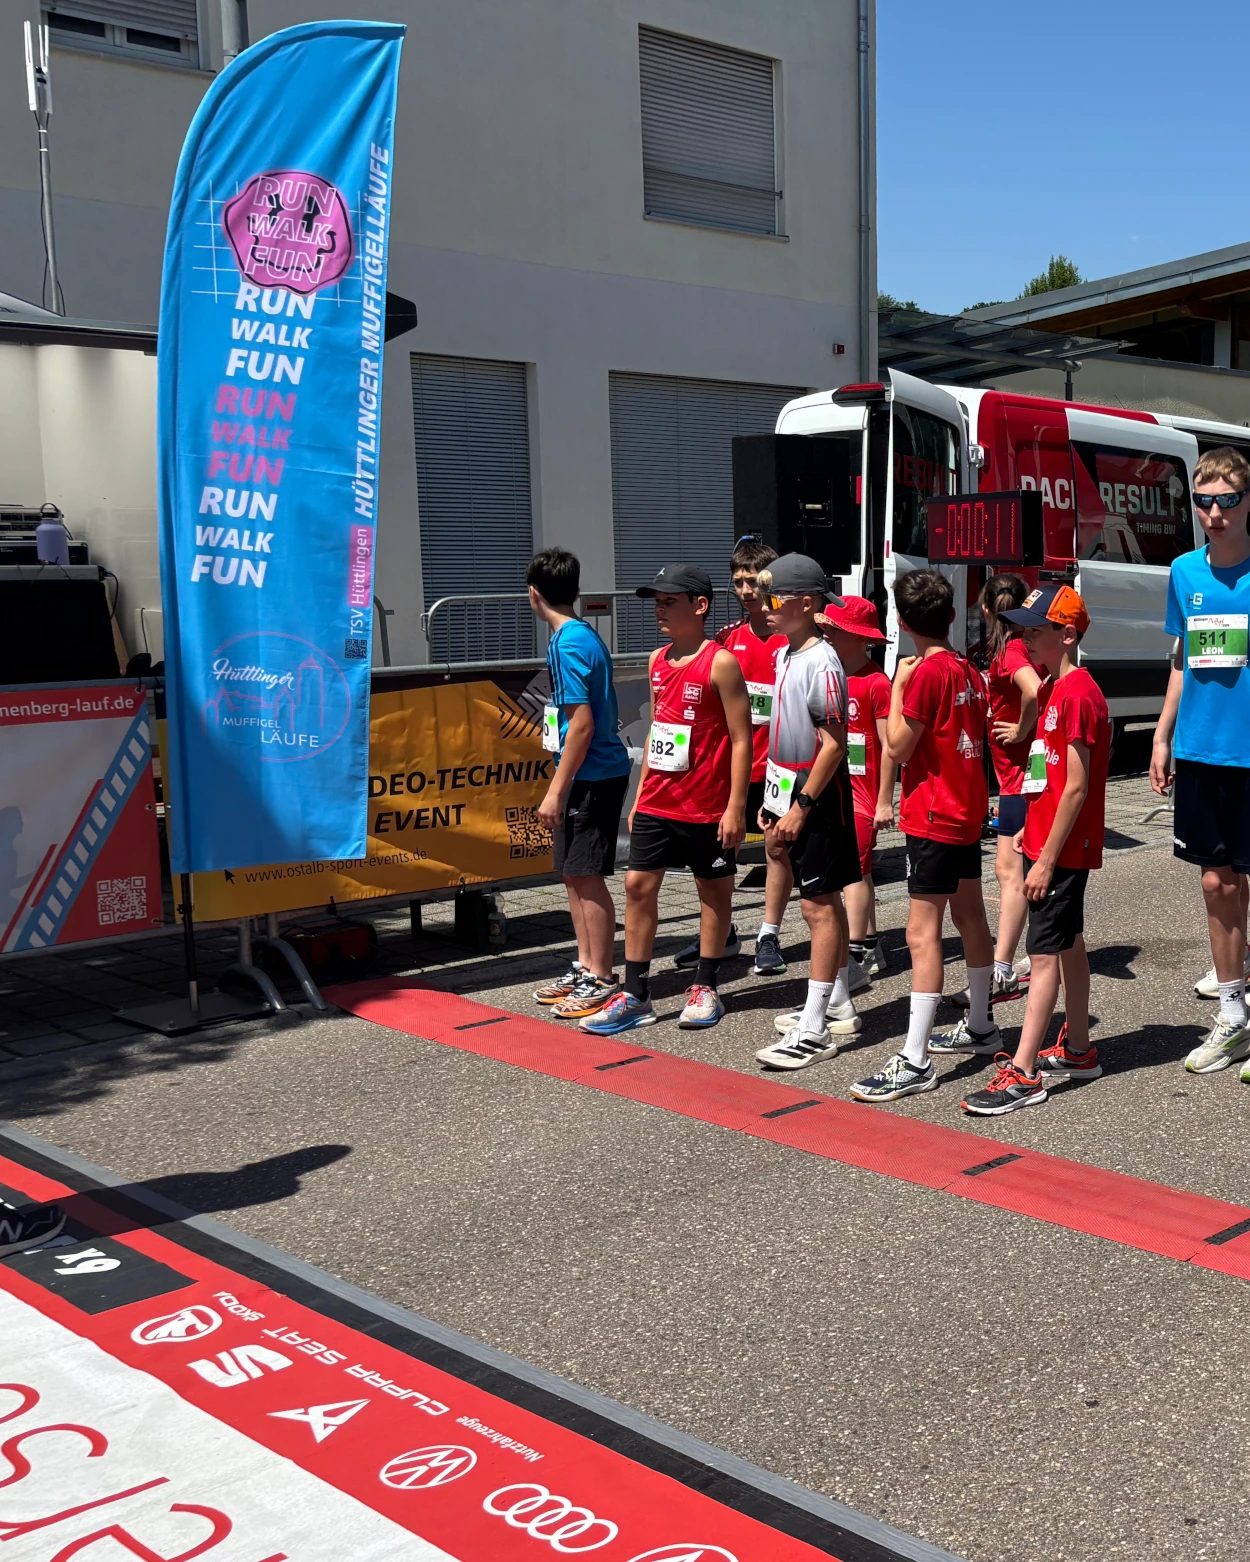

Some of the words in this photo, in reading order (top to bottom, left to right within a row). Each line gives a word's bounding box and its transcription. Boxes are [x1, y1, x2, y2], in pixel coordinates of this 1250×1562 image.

[253, 176, 336, 217] RUN
[250, 213, 332, 247] WALK
[244, 245, 325, 284] FUN
[361, 142, 389, 354] MUFFIGELLÄUFE
[235, 282, 317, 320] RUN
[231, 318, 313, 349] WALK
[225, 348, 305, 385] FUN
[215, 384, 297, 421] RUN
[211, 421, 293, 450] WALK
[352, 357, 379, 519] HÜTTLINGER
[207, 451, 285, 486] FUN
[198, 486, 278, 522] RUN
[1099, 481, 1176, 517] RESULT
[195, 525, 274, 553] WALK
[1136, 522, 1162, 534] TIMING
[1164, 524, 1176, 535] BW
[190, 554, 267, 589] FUN
[352, 528, 370, 605] Hüttlingen
[350, 609, 364, 635] TSV
[1199, 631, 1226, 646] 511
[1202, 647, 1224, 655] LEON
[212, 657, 295, 690] Hüttlinger
[222, 717, 280, 729] MUFFIGEL
[261, 731, 319, 748] LÄUFE
[651, 739, 675, 757] 682
[369, 759, 552, 798] DEO-TECHNIK
[766, 778, 779, 799] 70
[374, 803, 466, 834] EVENT
[245, 848, 428, 883] www.ostalb-sport-events.de
[212, 1290, 266, 1322] ŠKODA
[261, 1325, 348, 1366] SEAT
[344, 1363, 450, 1416] CUPRA
[456, 1416, 545, 1463] Nutzfahrzeuge
